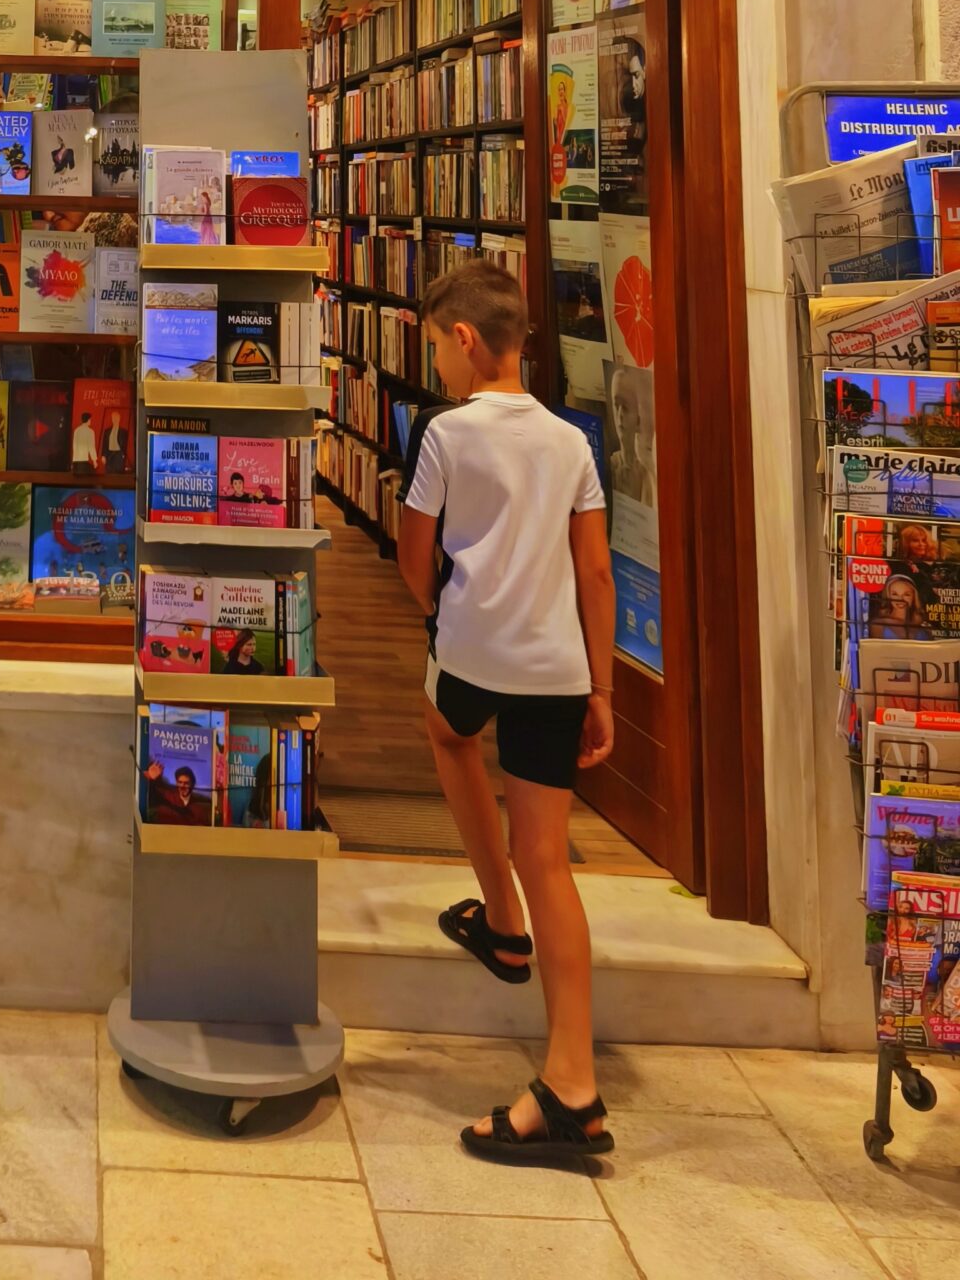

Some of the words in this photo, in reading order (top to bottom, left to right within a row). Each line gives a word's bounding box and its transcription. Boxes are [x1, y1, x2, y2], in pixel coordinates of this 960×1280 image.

[886, 103, 948, 115] HELLENIC
[48, 123, 78, 132] ΜΑΝΤΑ
[840, 121, 936, 136] DISTRIBUTION
[848, 183, 864, 202] Le
[864, 170, 904, 196] Mon
[252, 206, 304, 215] MYTHOLOGIE
[240, 211, 304, 228] GRECQUE
[29, 239, 60, 250] GABOR
[63, 239, 88, 251] MATÉ
[39, 269, 78, 281] ΜΥΑΛΟ
[110, 280, 128, 290] THE
[100, 289, 138, 302] DEFEND
[228, 315, 272, 325] MARKARIS
[152, 418, 167, 429] IAN
[170, 419, 207, 431] MANOOK
[172, 441, 200, 451] JOHANA
[161, 450, 210, 461] GUSTAWSSON
[224, 451, 258, 471] Love
[839, 452, 888, 469] marie
[907, 456, 960, 475] claire
[164, 476, 213, 491] MORSURES
[252, 474, 280, 485] Brain
[170, 493, 212, 509] SILENCE
[56, 515, 68, 523] ΜΕ
[70, 515, 85, 524] ΜΙΑ
[851, 563, 889, 576] POINT
[852, 574, 866, 583] DE
[152, 581, 186, 589] TOSHIKAZU
[223, 585, 262, 594] Sandrine
[151, 599, 162, 607] DES
[220, 593, 264, 604] Collette
[220, 607, 264, 616] MADELAINE
[217, 616, 242, 625] AVANT
[243, 617, 268, 626] L'AUBE
[153, 729, 209, 745] PANAYOTIS
[161, 739, 201, 752] PASCOT
[234, 754, 243, 764] LA
[907, 786, 940, 796] EXTRA
